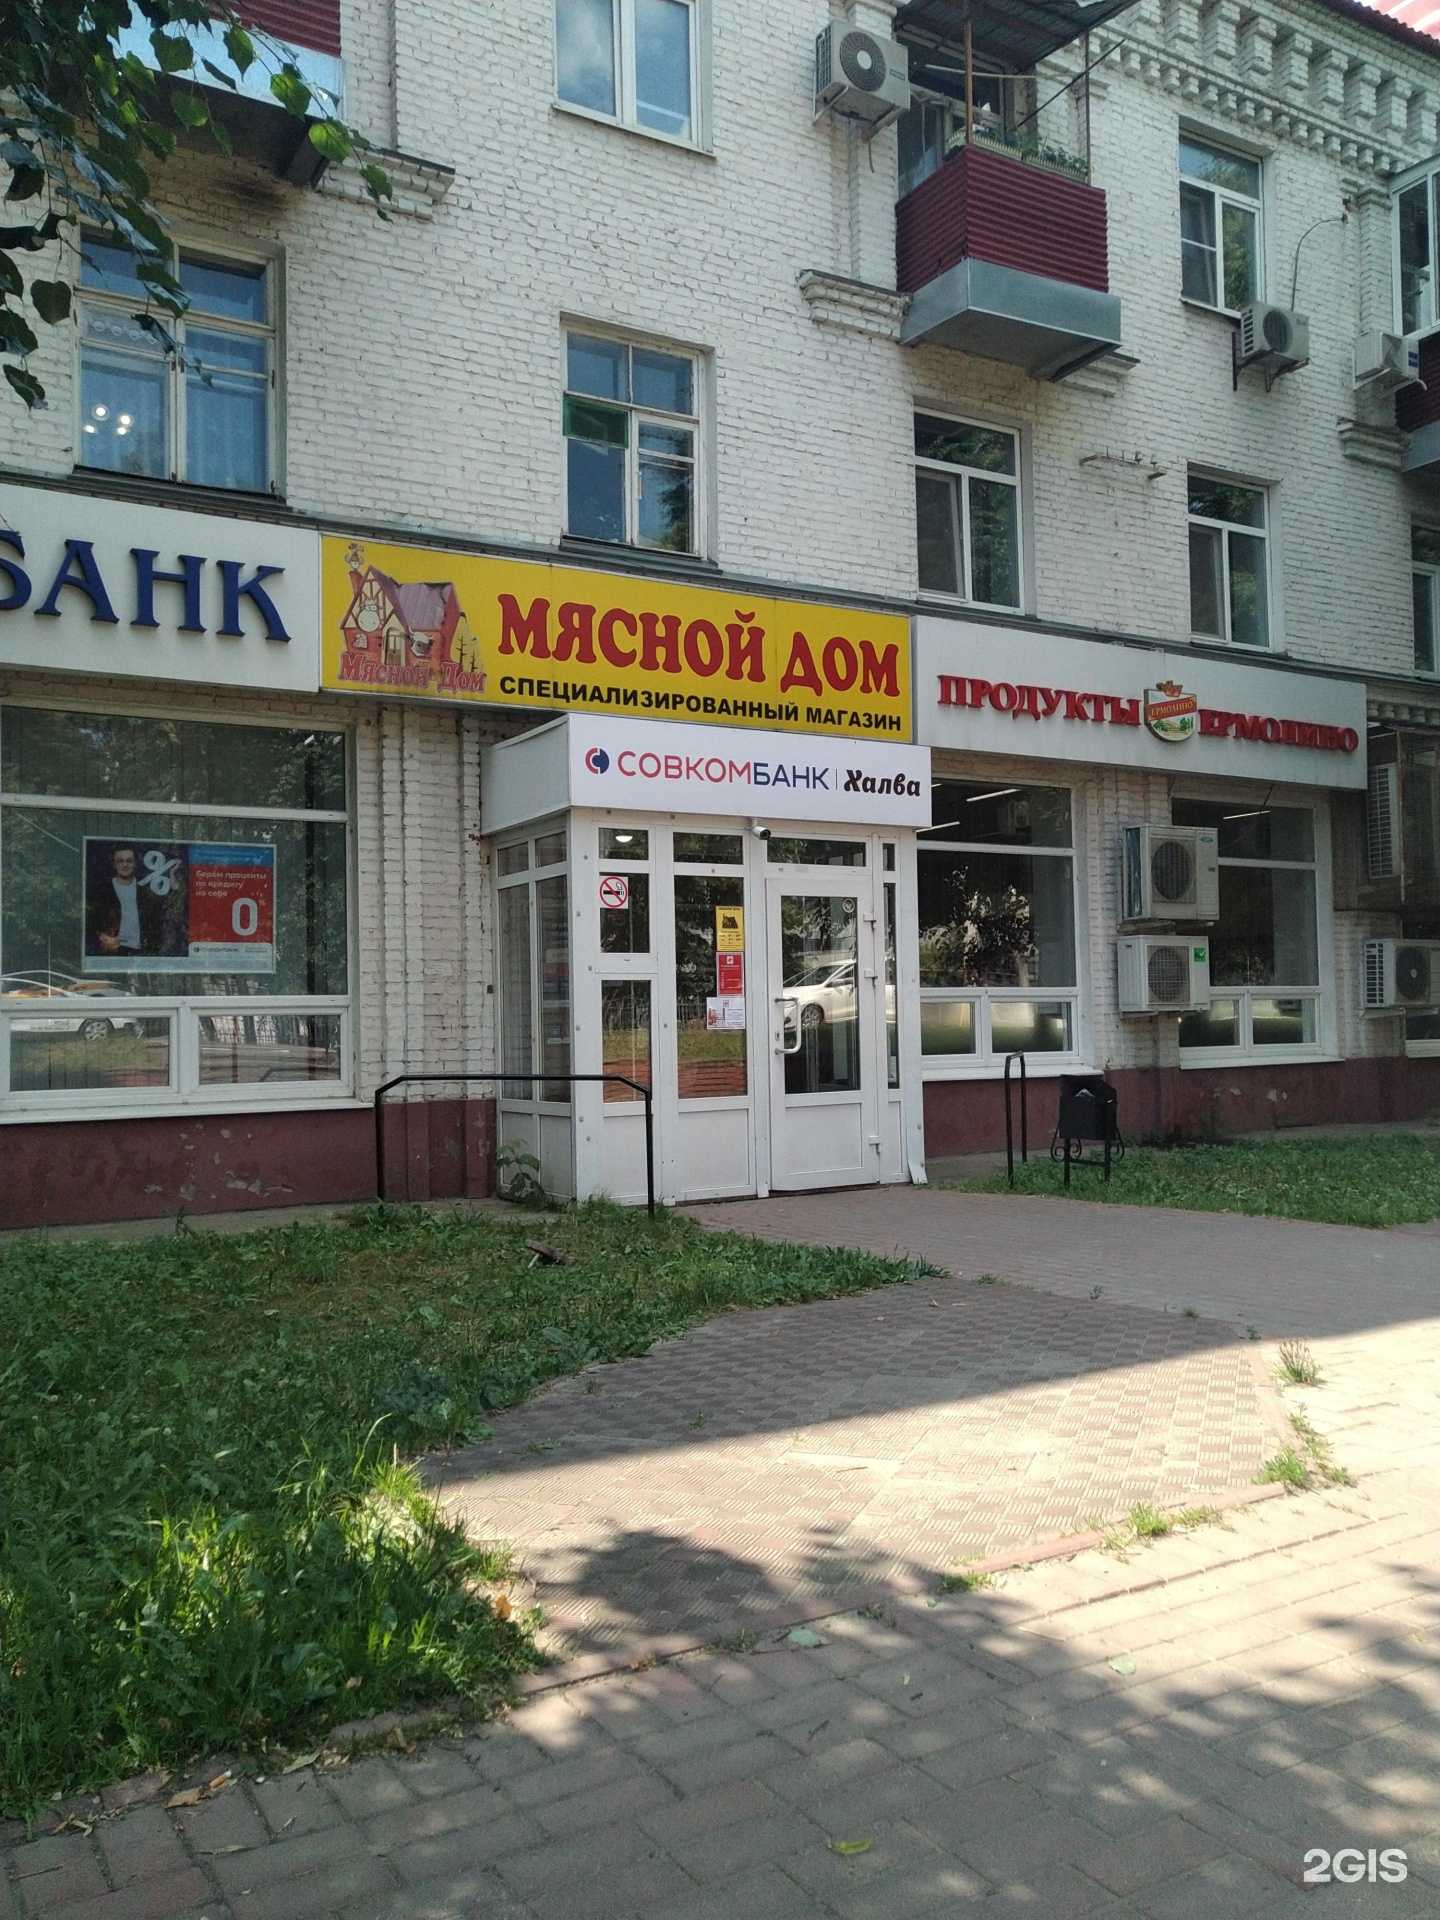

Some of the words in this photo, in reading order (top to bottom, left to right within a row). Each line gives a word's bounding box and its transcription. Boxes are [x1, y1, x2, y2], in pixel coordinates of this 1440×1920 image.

[497, 593, 767, 684] МЯСНОЙ
[780, 631, 901, 698] ДОМ
[438, 660, 488, 694] Дом
[499, 675, 799, 722] СПЕЦИАЛИЗИРОВАННЫЙ
[806, 707, 902, 732] МАГАЗИН
[937, 674, 1141, 727] ПРОДУКТЫ
[1198, 708, 1360, 754] ЕРМОЛИНО
[617, 750, 830, 790] СОВКОМБАНК
[843, 768, 921, 797] Халва
